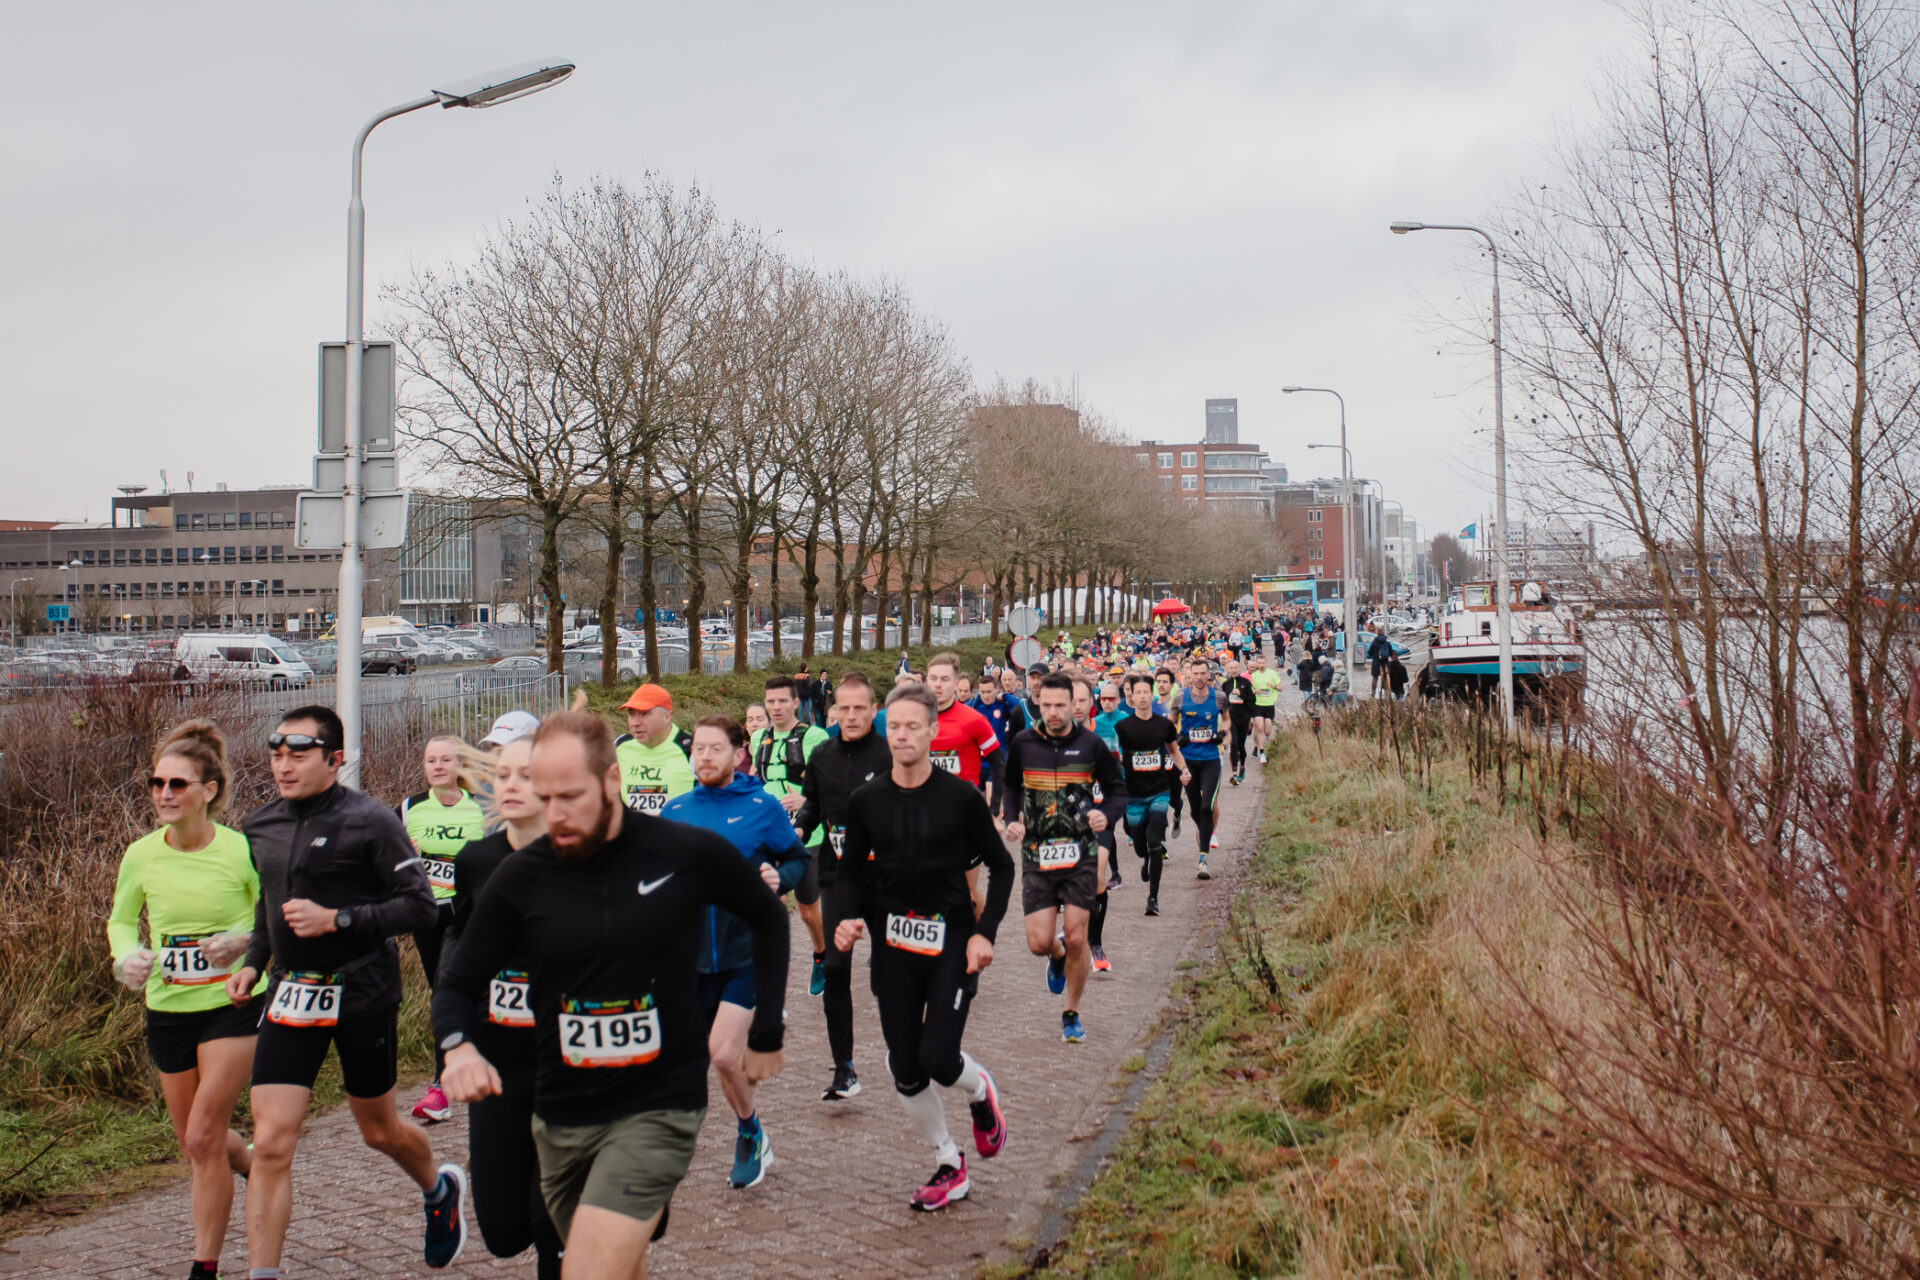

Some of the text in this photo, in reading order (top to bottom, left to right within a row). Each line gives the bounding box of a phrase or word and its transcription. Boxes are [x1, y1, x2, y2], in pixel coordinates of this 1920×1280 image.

[48, 607, 60, 618] B3
[1190, 730, 1211, 738] 4128
[928, 758, 955, 771] 047
[1134, 756, 1159, 766] 2236
[629, 795, 666, 811] 2262
[1042, 845, 1077, 861] 2273
[423, 860, 455, 880] 226
[891, 916, 939, 943] 4065
[163, 949, 214, 972] 418
[279, 986, 335, 1012] 4176
[495, 983, 528, 1011] 22
[566, 1015, 652, 1048] 2195
